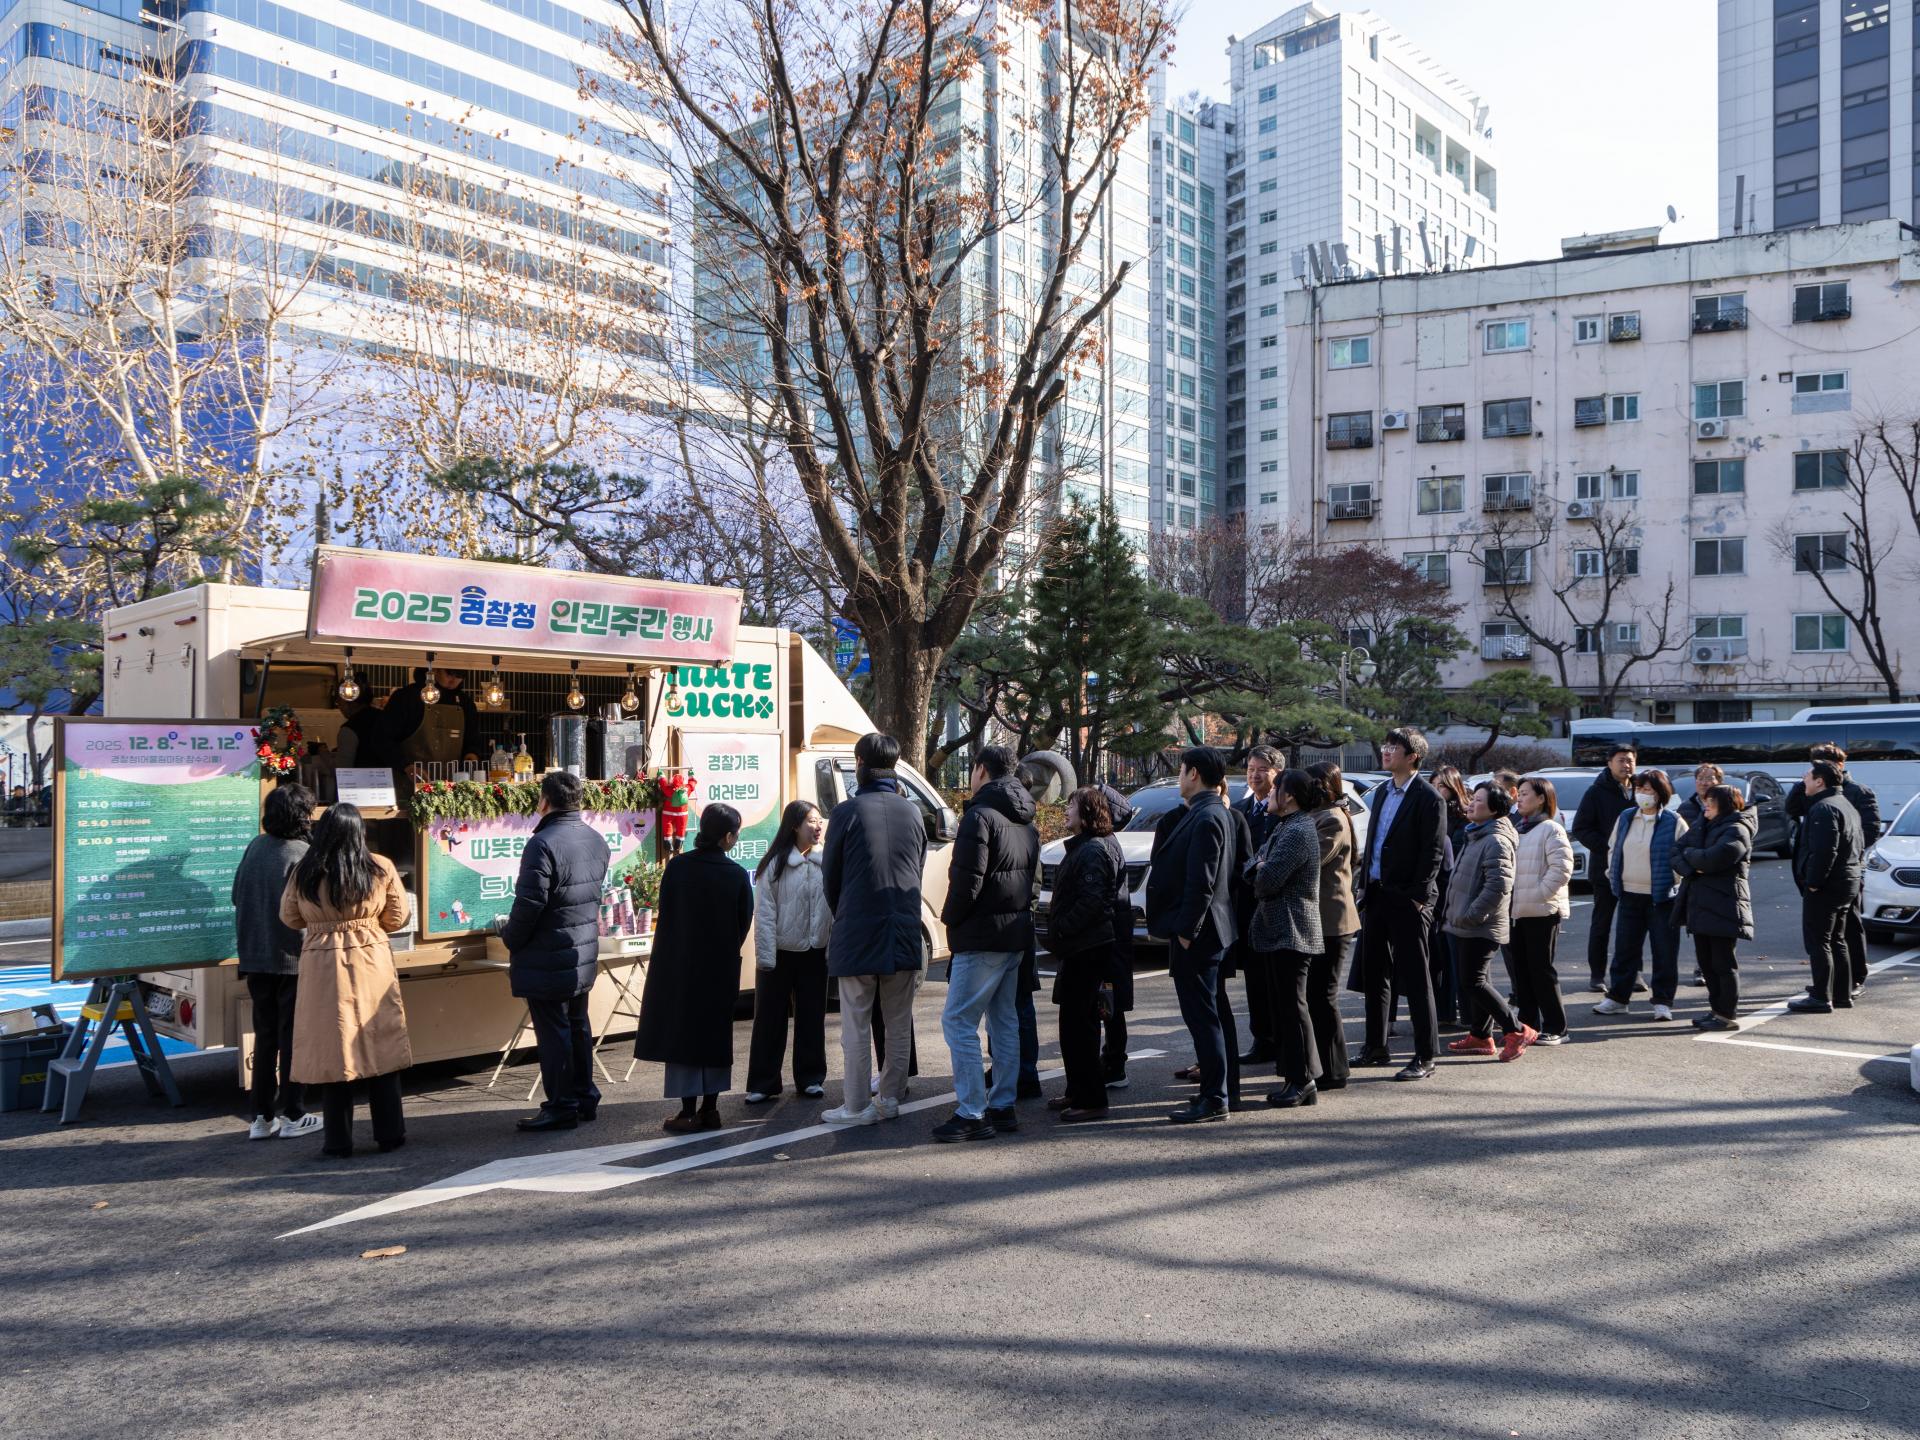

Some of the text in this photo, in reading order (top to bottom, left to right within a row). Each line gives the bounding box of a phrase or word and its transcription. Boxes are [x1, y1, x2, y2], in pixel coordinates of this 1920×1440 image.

[354, 588, 714, 642] 2025 경찰청 인권주간 행사
[667, 663, 772, 690] MATE
[708, 754, 759, 771] 경찰가족
[708, 784, 759, 800] 여러분의
